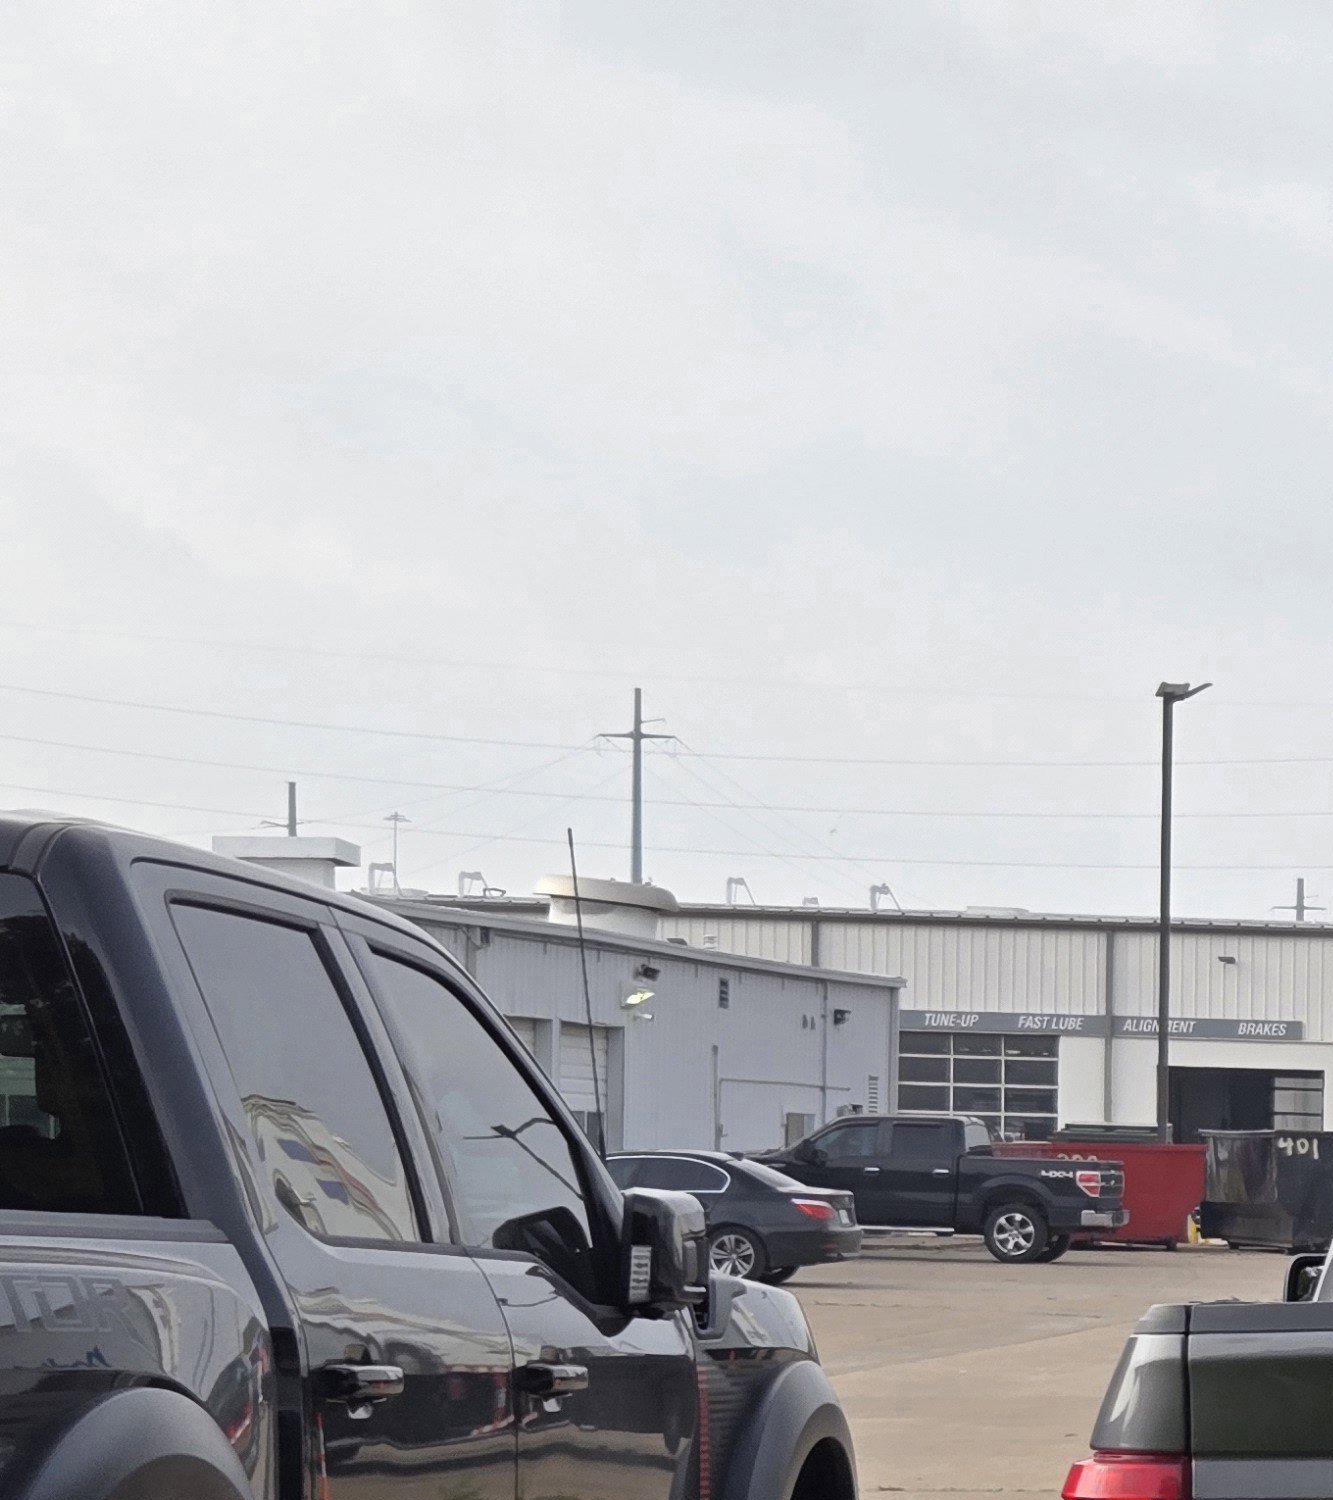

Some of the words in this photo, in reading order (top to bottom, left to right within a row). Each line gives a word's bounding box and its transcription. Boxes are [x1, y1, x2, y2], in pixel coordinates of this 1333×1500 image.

[924, 1013, 979, 1027] TUNE-UP
[1018, 1016, 1049, 1029] FAST
[1051, 1017, 1084, 1030] LUBE
[1238, 1022, 1287, 1036] BRAKES
[1278, 1137, 1319, 1160] 401
